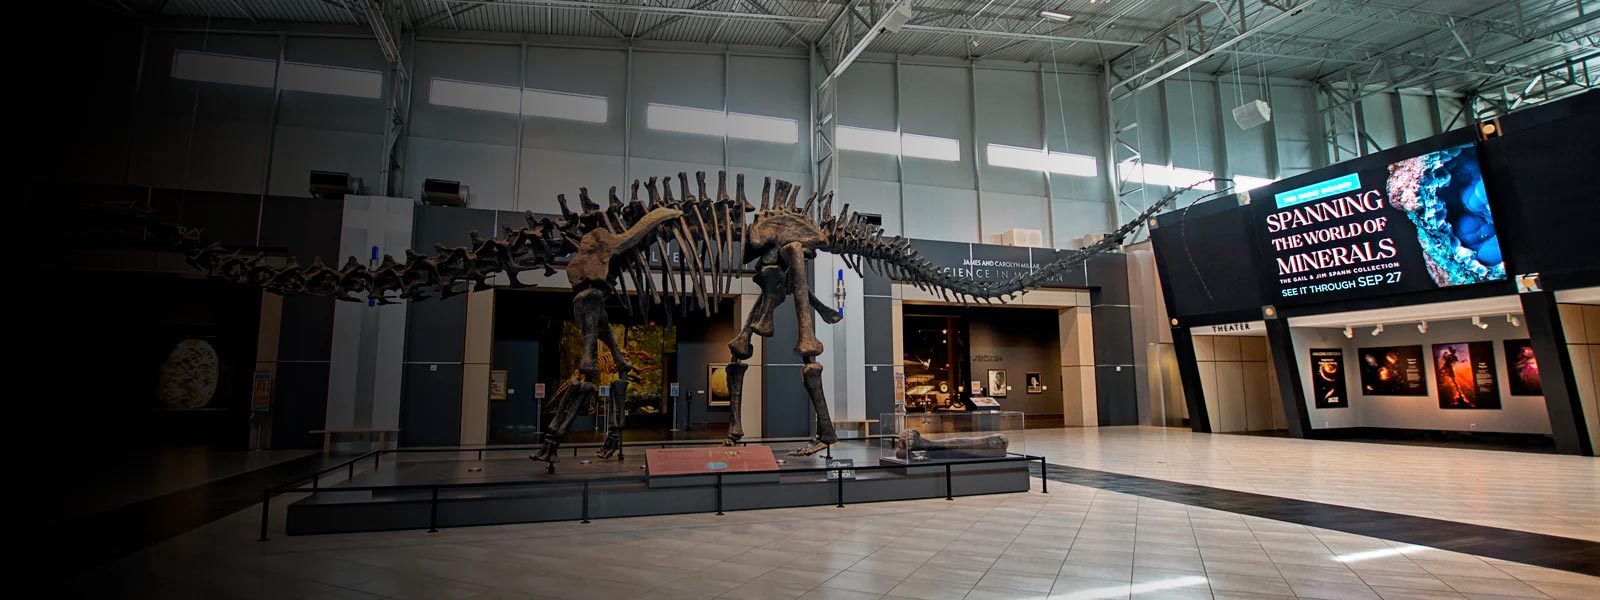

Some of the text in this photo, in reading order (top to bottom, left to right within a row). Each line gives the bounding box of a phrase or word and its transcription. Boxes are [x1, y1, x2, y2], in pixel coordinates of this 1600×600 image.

[1266, 189, 1384, 233] SPANNING
[1271, 216, 1388, 251] THE WORLD OF
[981, 259, 994, 267] AND
[994, 260, 1020, 269] CAROLYN
[1276, 237, 1397, 275] MINERALS
[937, 267, 990, 279] CIENCE
[996, 270, 1009, 279] IN
[1281, 271, 1402, 297] SEE IT THROUGH SEP 27
[1293, 275, 1308, 283] GAIL
[1329, 269, 1352, 277] SPANN
[1353, 261, 1400, 274] COLLECTION
[1212, 323, 1250, 333] THEATER
